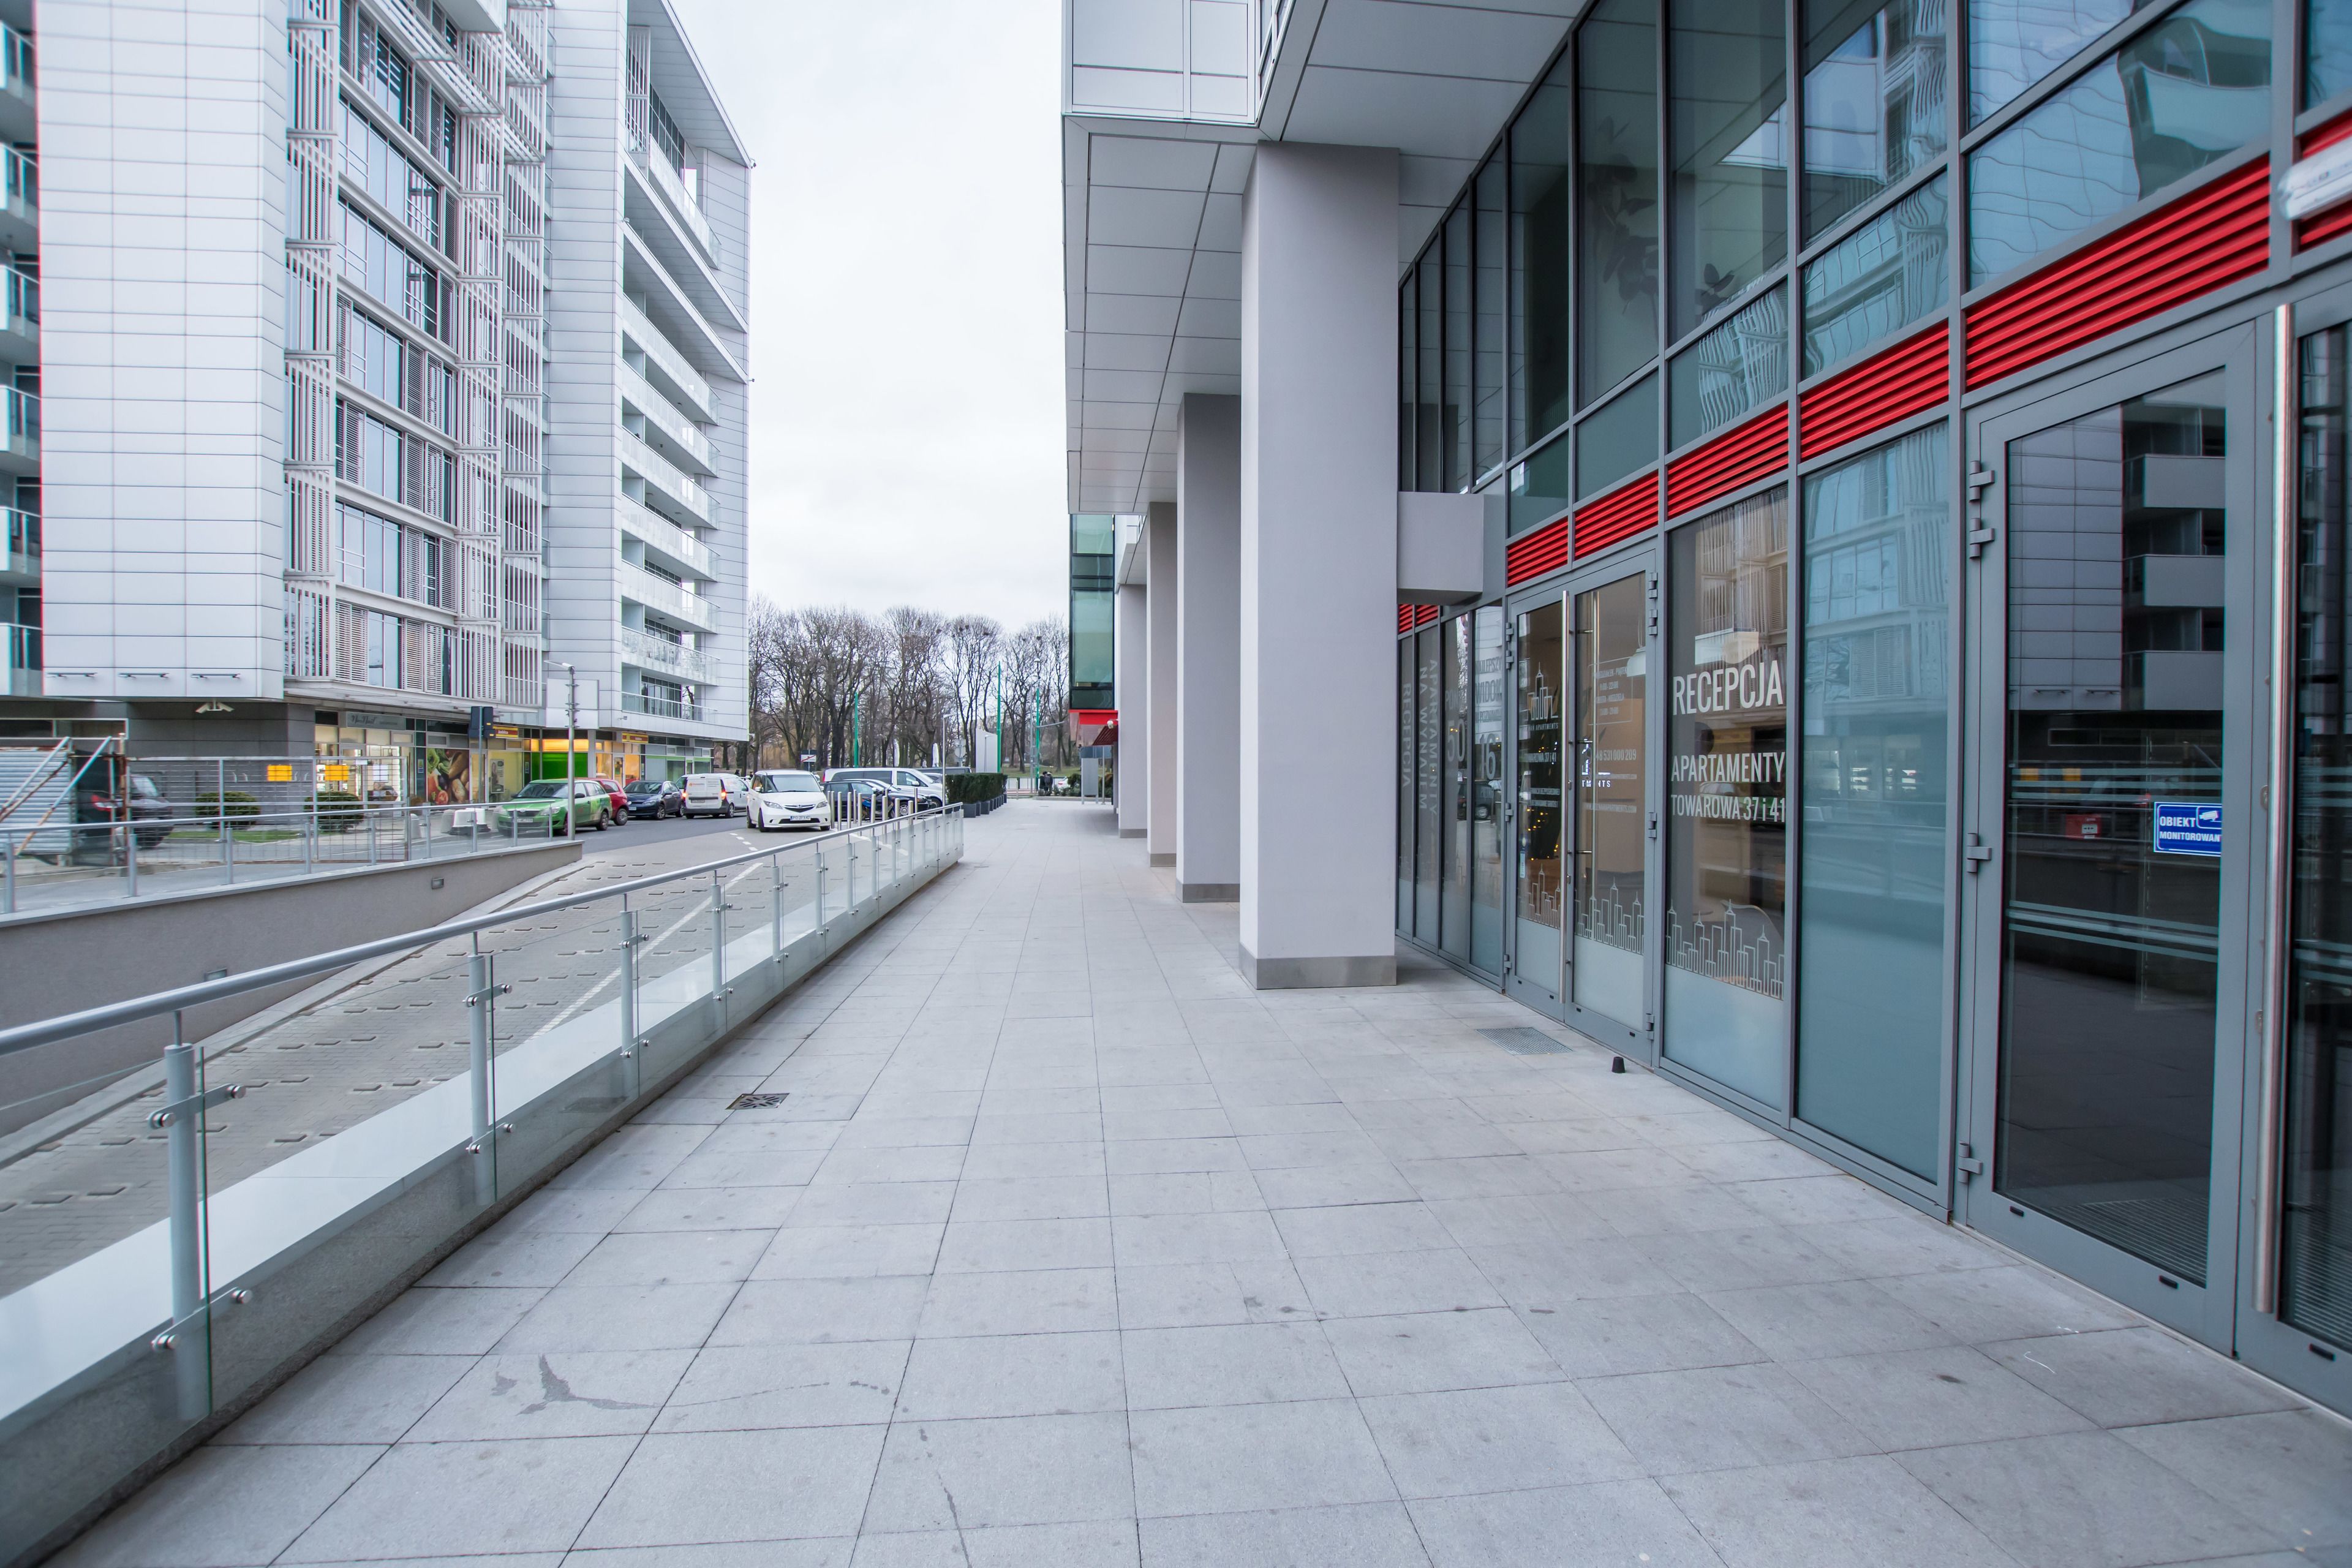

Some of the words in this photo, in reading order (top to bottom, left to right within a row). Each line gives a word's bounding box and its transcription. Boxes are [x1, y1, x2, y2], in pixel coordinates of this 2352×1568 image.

[1673, 660, 1783, 715] RECEPCJA
[1447, 718, 1465, 762] 50
[1480, 733, 1496, 780] 16
[1671, 752, 1785, 782] APARTAMENTY
[1671, 794, 1741, 820] TOWAROWA
[1743, 796, 1759, 821] 37
[1762, 797, 1766, 821] i
[1770, 797, 1785, 823] 41
[2159, 816, 2196, 827] OBIEKT
